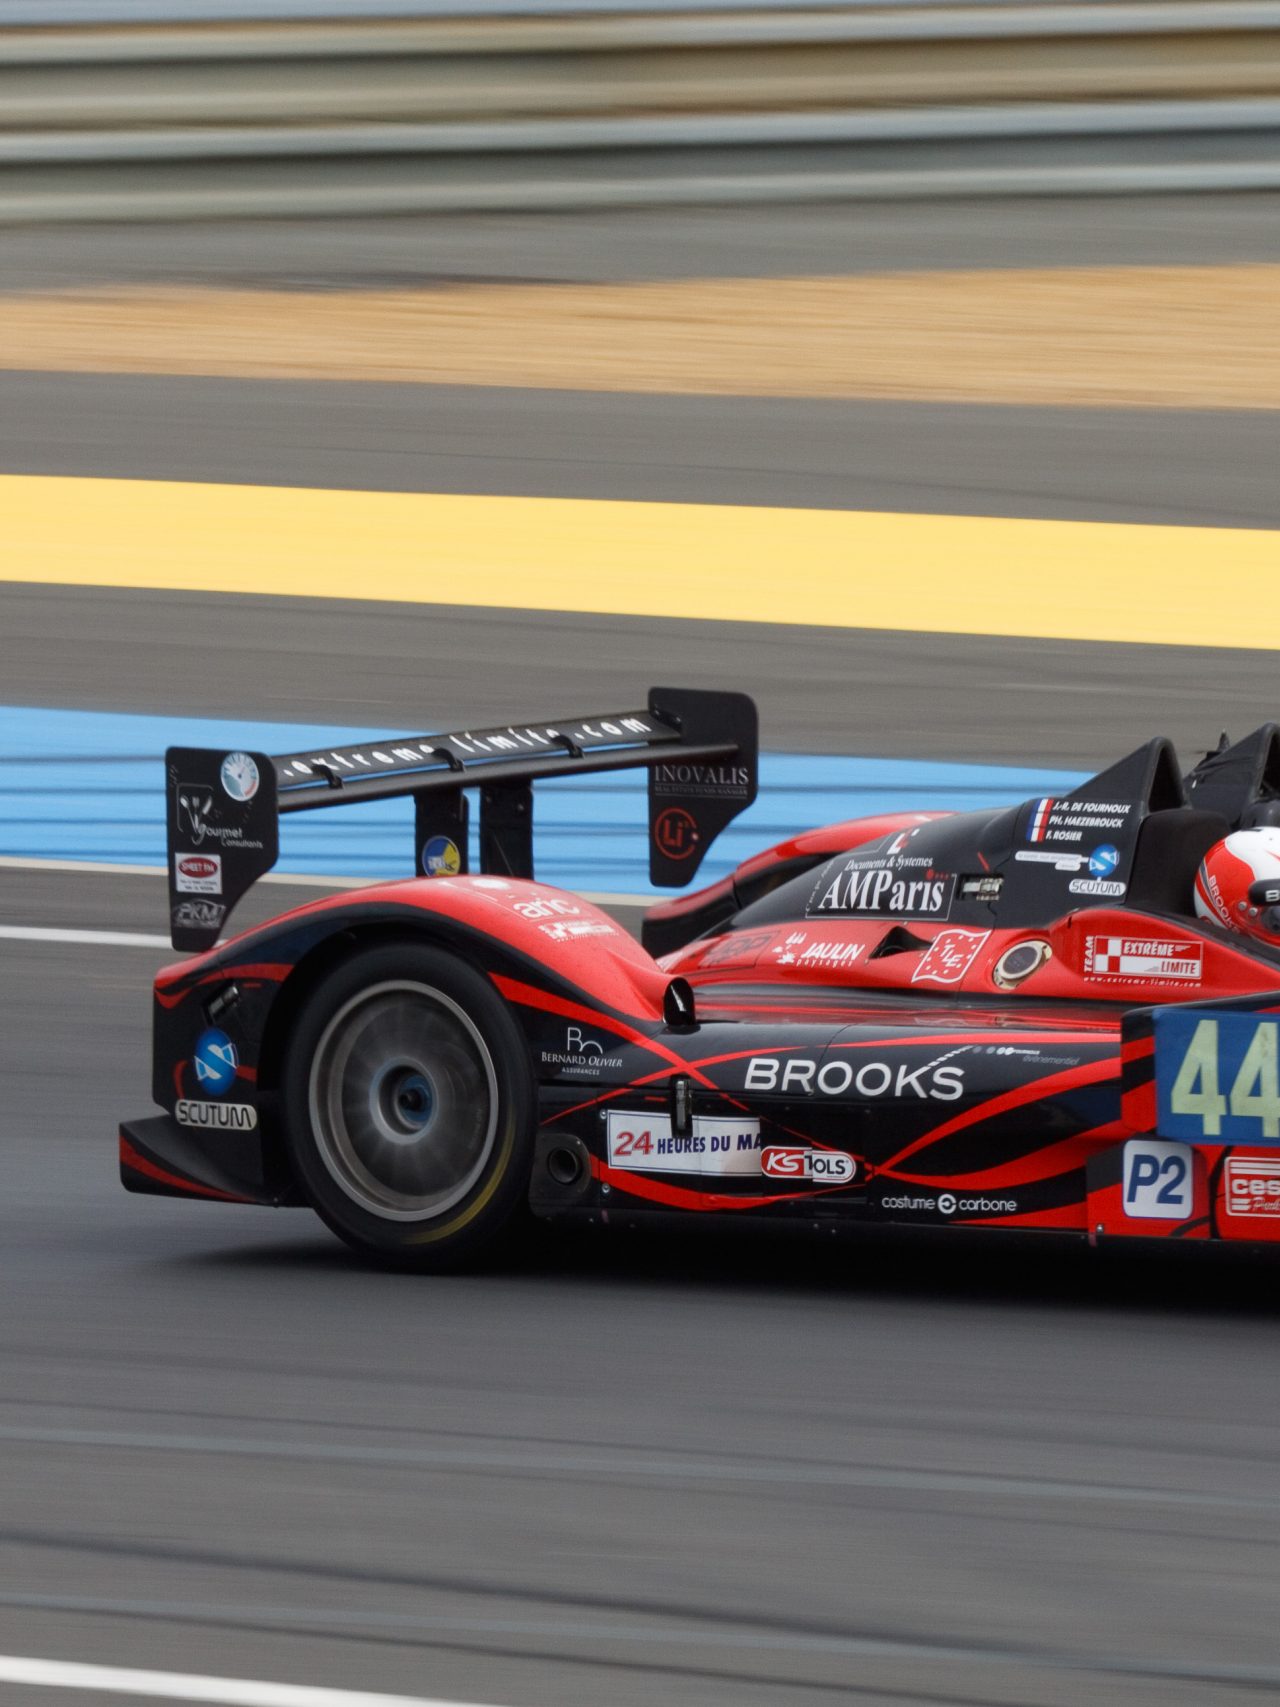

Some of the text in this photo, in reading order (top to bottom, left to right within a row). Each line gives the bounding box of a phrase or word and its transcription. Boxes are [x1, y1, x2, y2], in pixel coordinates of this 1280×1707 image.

[655, 765, 749, 785] INOVALIS
[1071, 802, 1081, 811] DE
[1082, 803, 1131, 814] FOURNOUX
[1049, 815, 1124, 828] PH. HAEZEBROUCK
[1053, 831, 1083, 841] ROSIER
[845, 859, 885, 871] Documents
[887, 857, 896, 867] &
[817, 869, 945, 913] AMParis
[1071, 881, 1122, 895] SCUTUM
[801, 943, 866, 960] JAULIN
[1083, 935, 1094, 973] TEAM
[797, 958, 854, 968] paysages
[1161, 961, 1196, 975] LIMITE
[541, 1051, 623, 1068] BERNARD OLIVIER
[562, 1066, 600, 1076] ASSURANCES
[744, 1045, 974, 1101] BROOKS
[179, 1102, 252, 1128] SCUTUM
[613, 1131, 654, 1157] 24
[657, 1135, 706, 1155] HEURES
[710, 1135, 730, 1153] DU
[766, 1152, 805, 1173] KS
[1127, 1154, 1187, 1205] P2
[881, 1195, 1017, 1212] costume carbone
